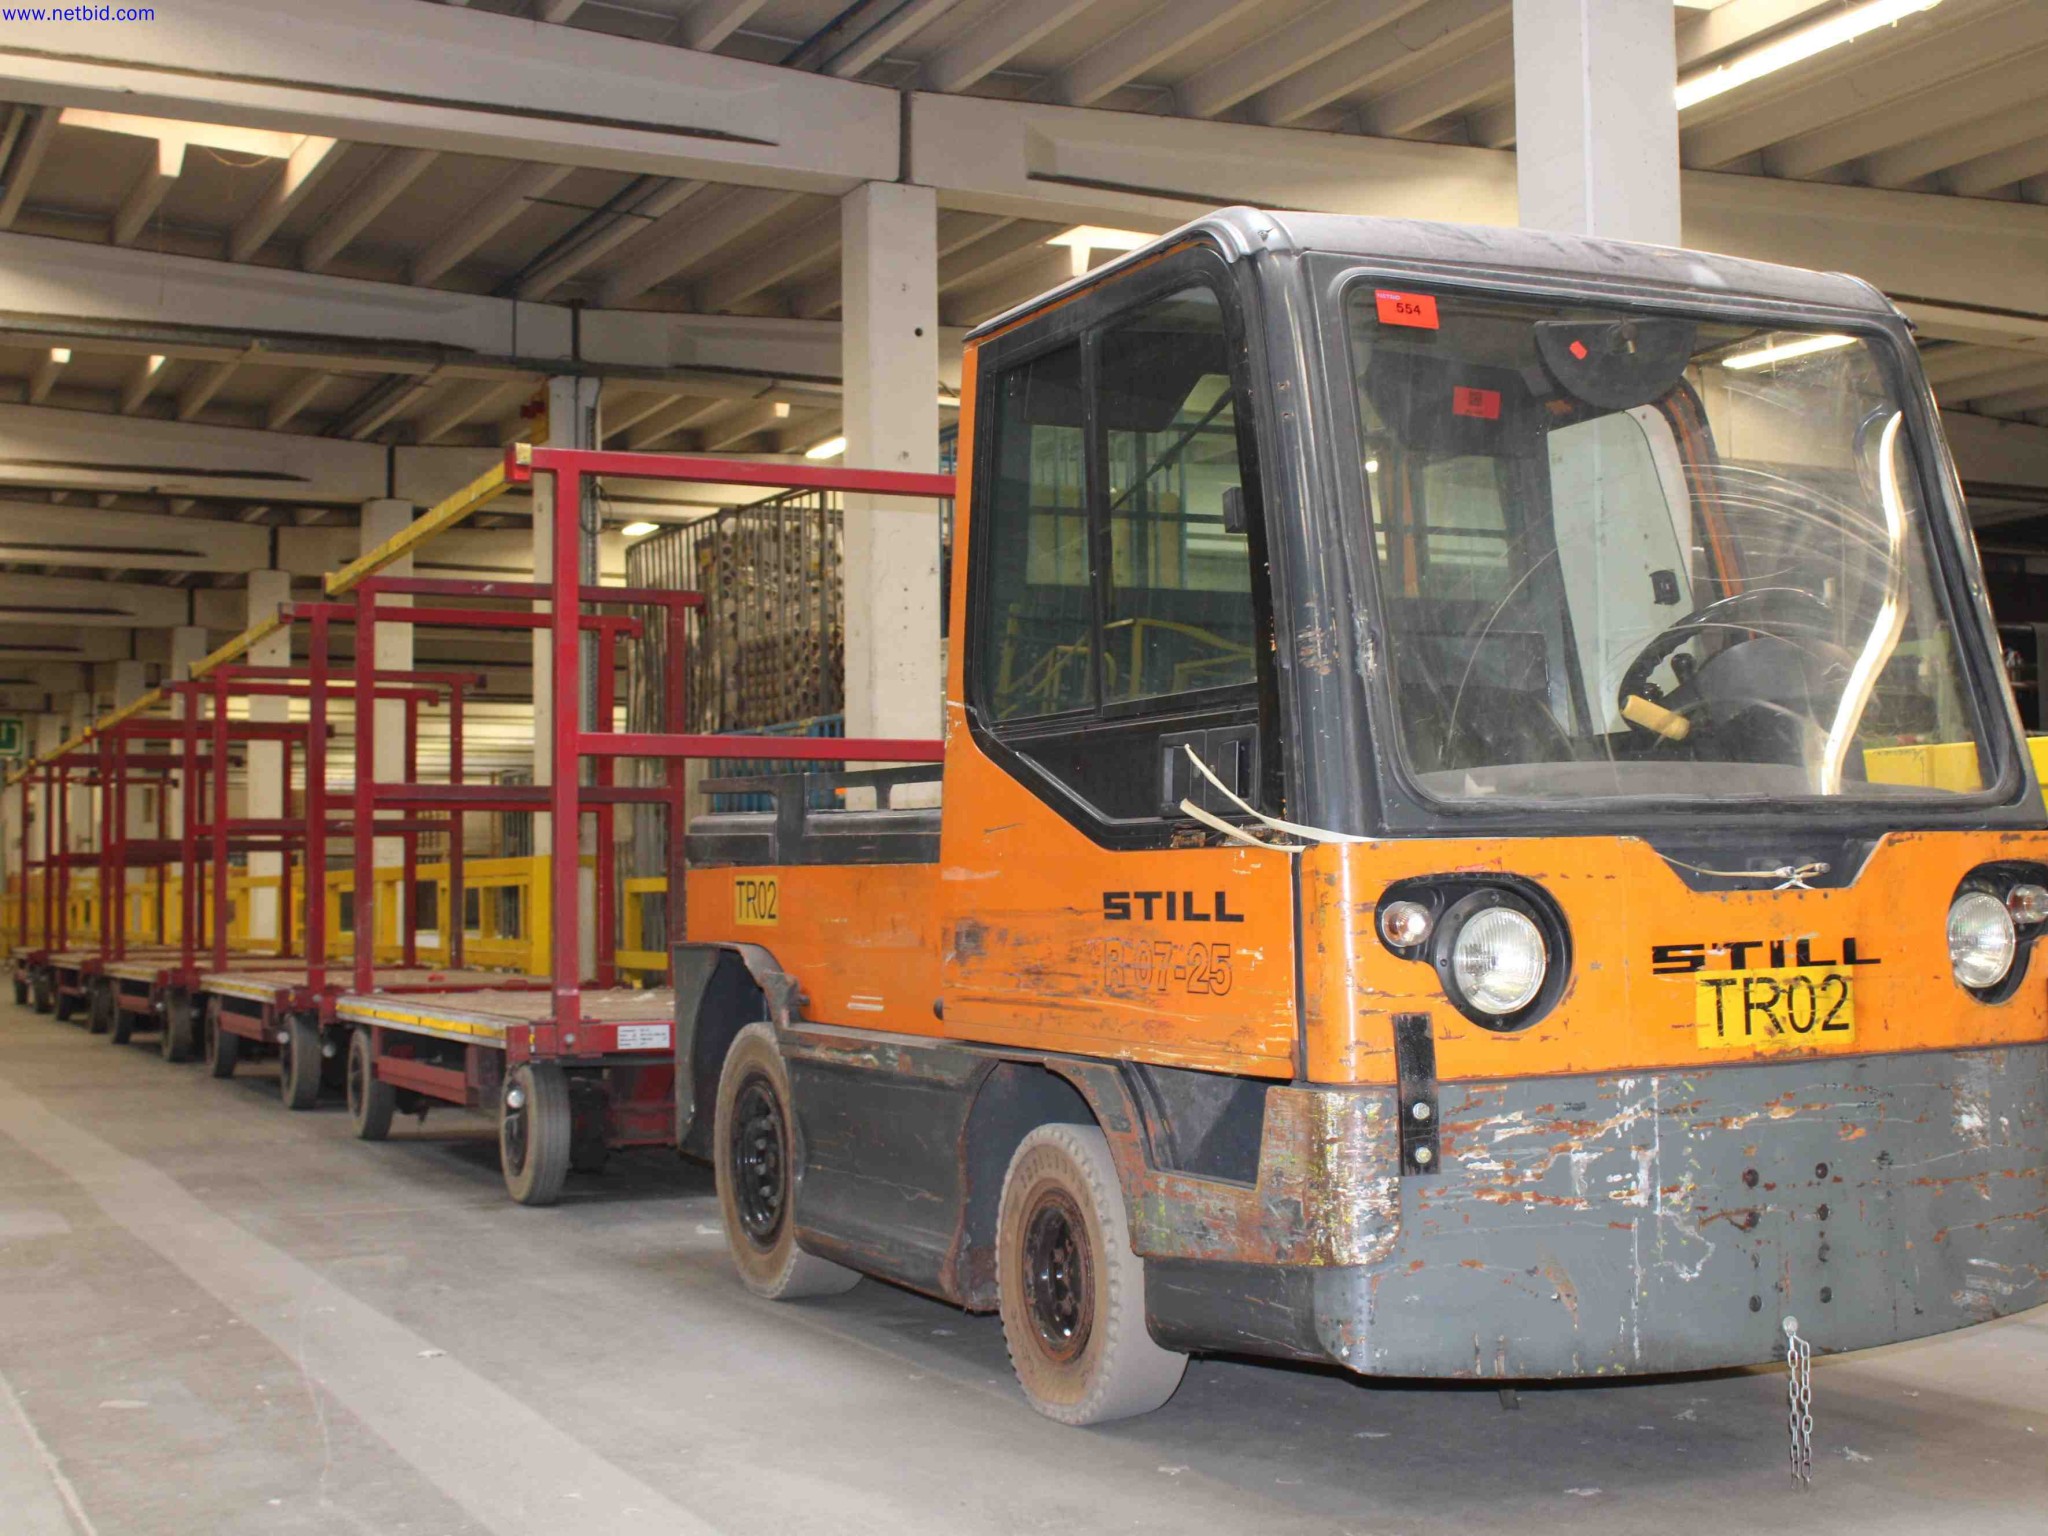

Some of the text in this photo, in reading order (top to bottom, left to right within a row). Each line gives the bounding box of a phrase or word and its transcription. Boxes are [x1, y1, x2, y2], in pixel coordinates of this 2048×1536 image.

[1396, 302, 1421, 316] 554
[736, 880, 777, 919] TR02
[1103, 891, 1244, 922] STILL
[1652, 938, 1881, 975] STILL
[1700, 973, 1850, 1037] TR02
